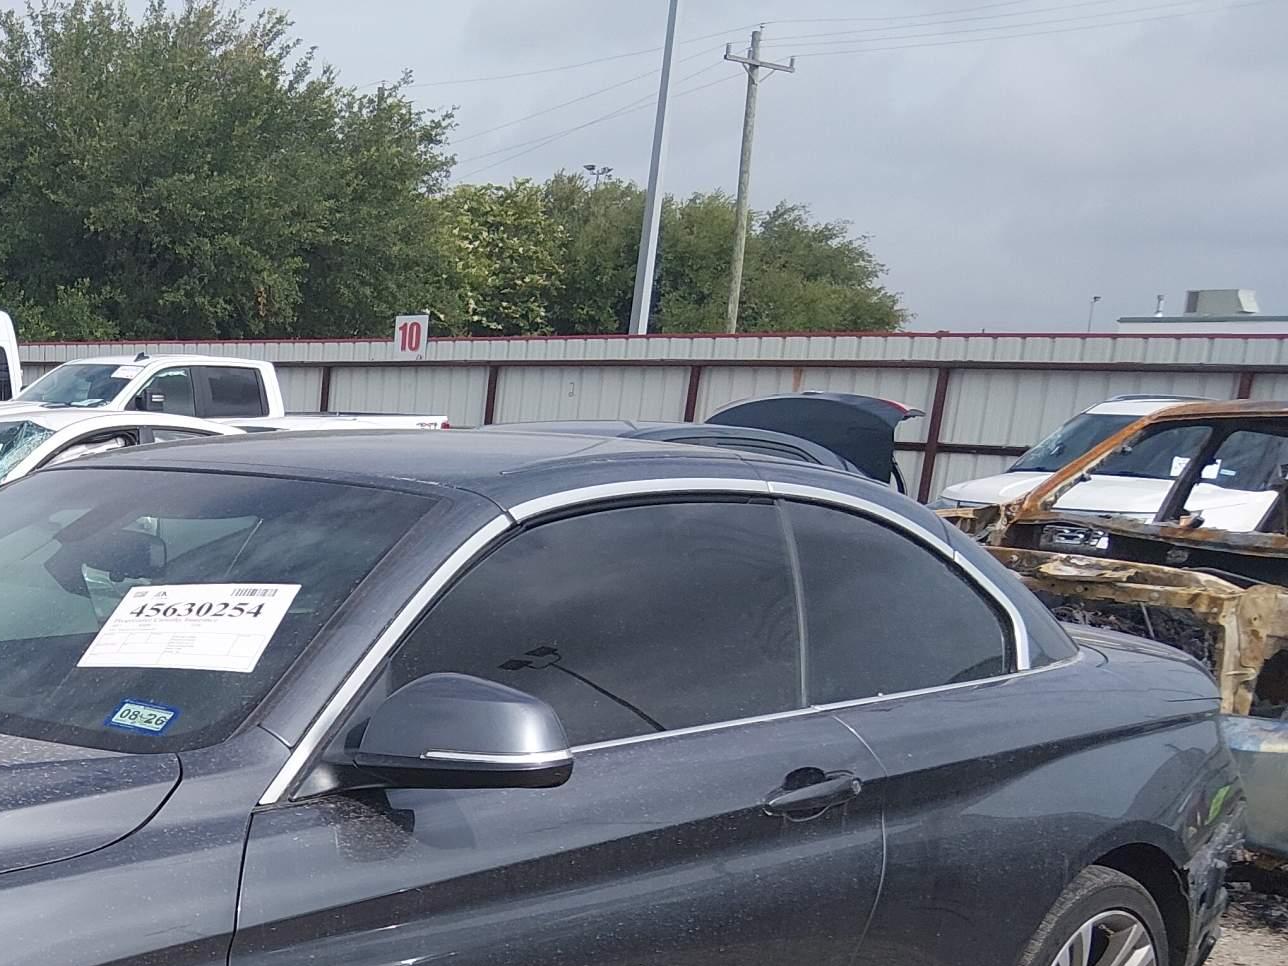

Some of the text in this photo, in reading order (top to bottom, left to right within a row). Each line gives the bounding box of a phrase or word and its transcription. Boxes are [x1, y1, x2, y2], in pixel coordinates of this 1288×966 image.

[399, 321, 422, 352] 10
[129, 601, 265, 618] 45630254
[119, 708, 141, 720] 08
